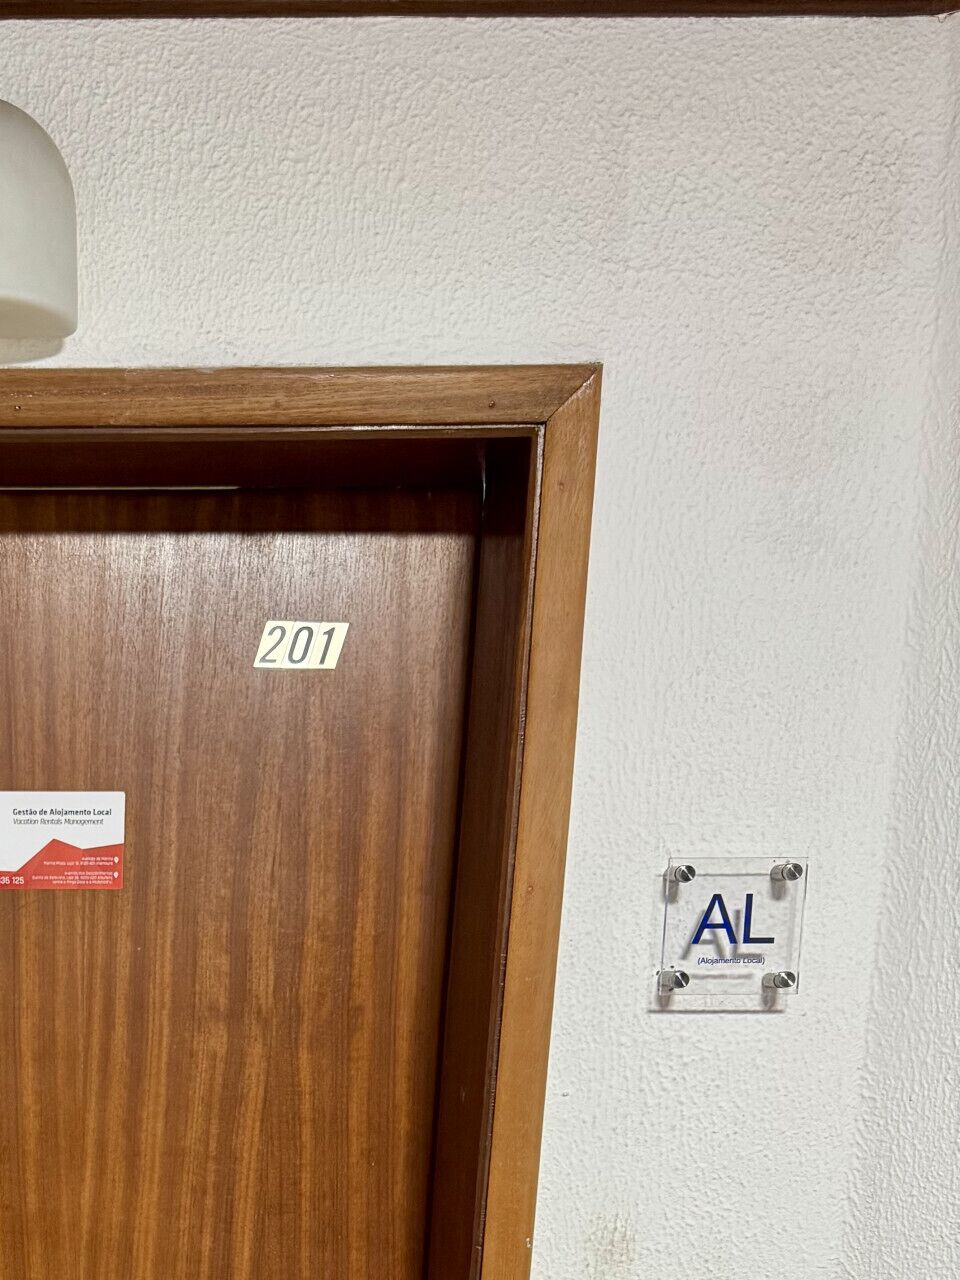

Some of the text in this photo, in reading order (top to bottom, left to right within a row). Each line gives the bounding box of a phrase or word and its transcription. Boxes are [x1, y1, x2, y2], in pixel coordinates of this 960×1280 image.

[258, 625, 336, 665] 201
[12, 808, 112, 817] Gestão de Alojamento Local
[64, 818, 104, 826] Management
[690, 893, 775, 945] AL
[697, 956, 766, 966] (Alojamento Local)
